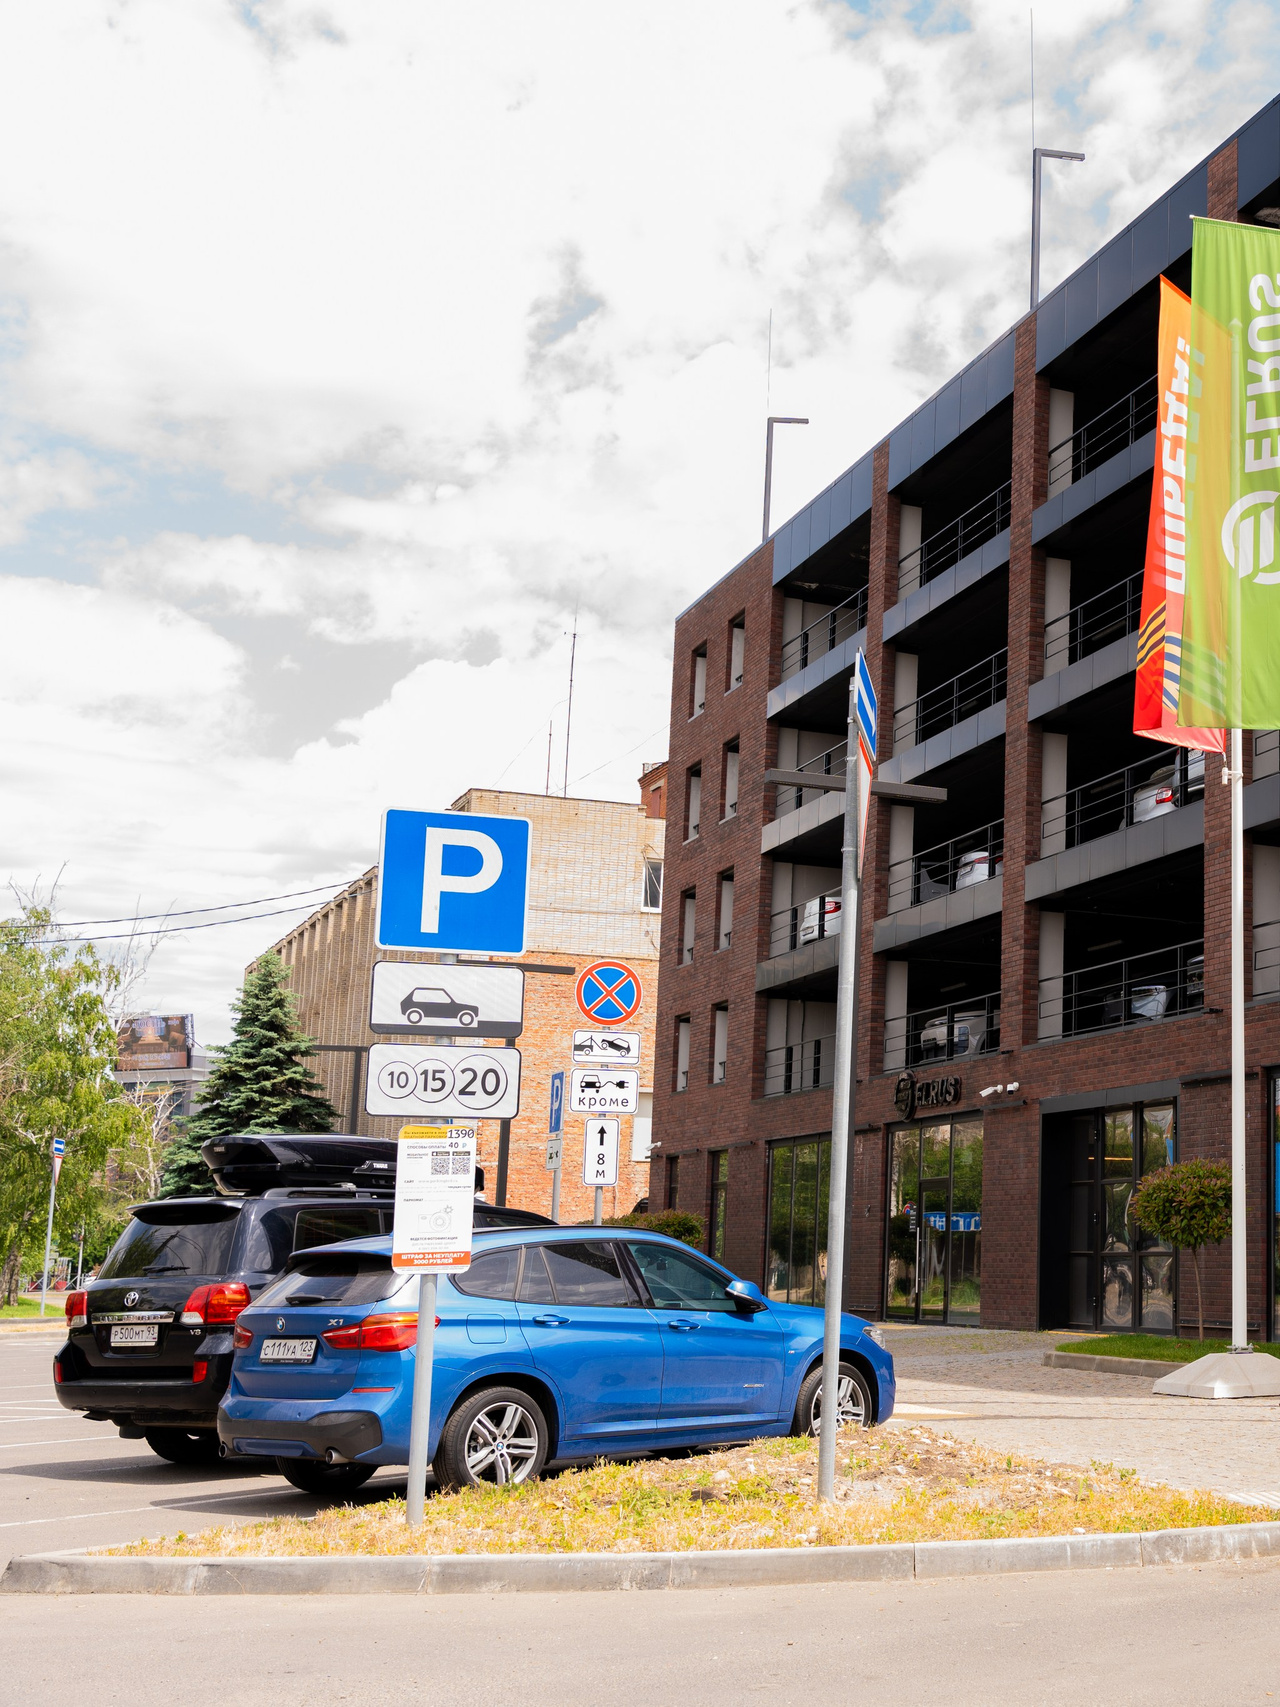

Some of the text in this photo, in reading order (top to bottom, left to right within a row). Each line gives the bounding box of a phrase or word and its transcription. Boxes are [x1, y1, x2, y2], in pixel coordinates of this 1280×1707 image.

[387, 1067, 501, 1096] 10 15 20
[578, 1096, 629, 1109] кроме
[448, 1129, 475, 1138] 1390
[597, 1153, 605, 1165] 8
[328, 1318, 344, 1326] X1
